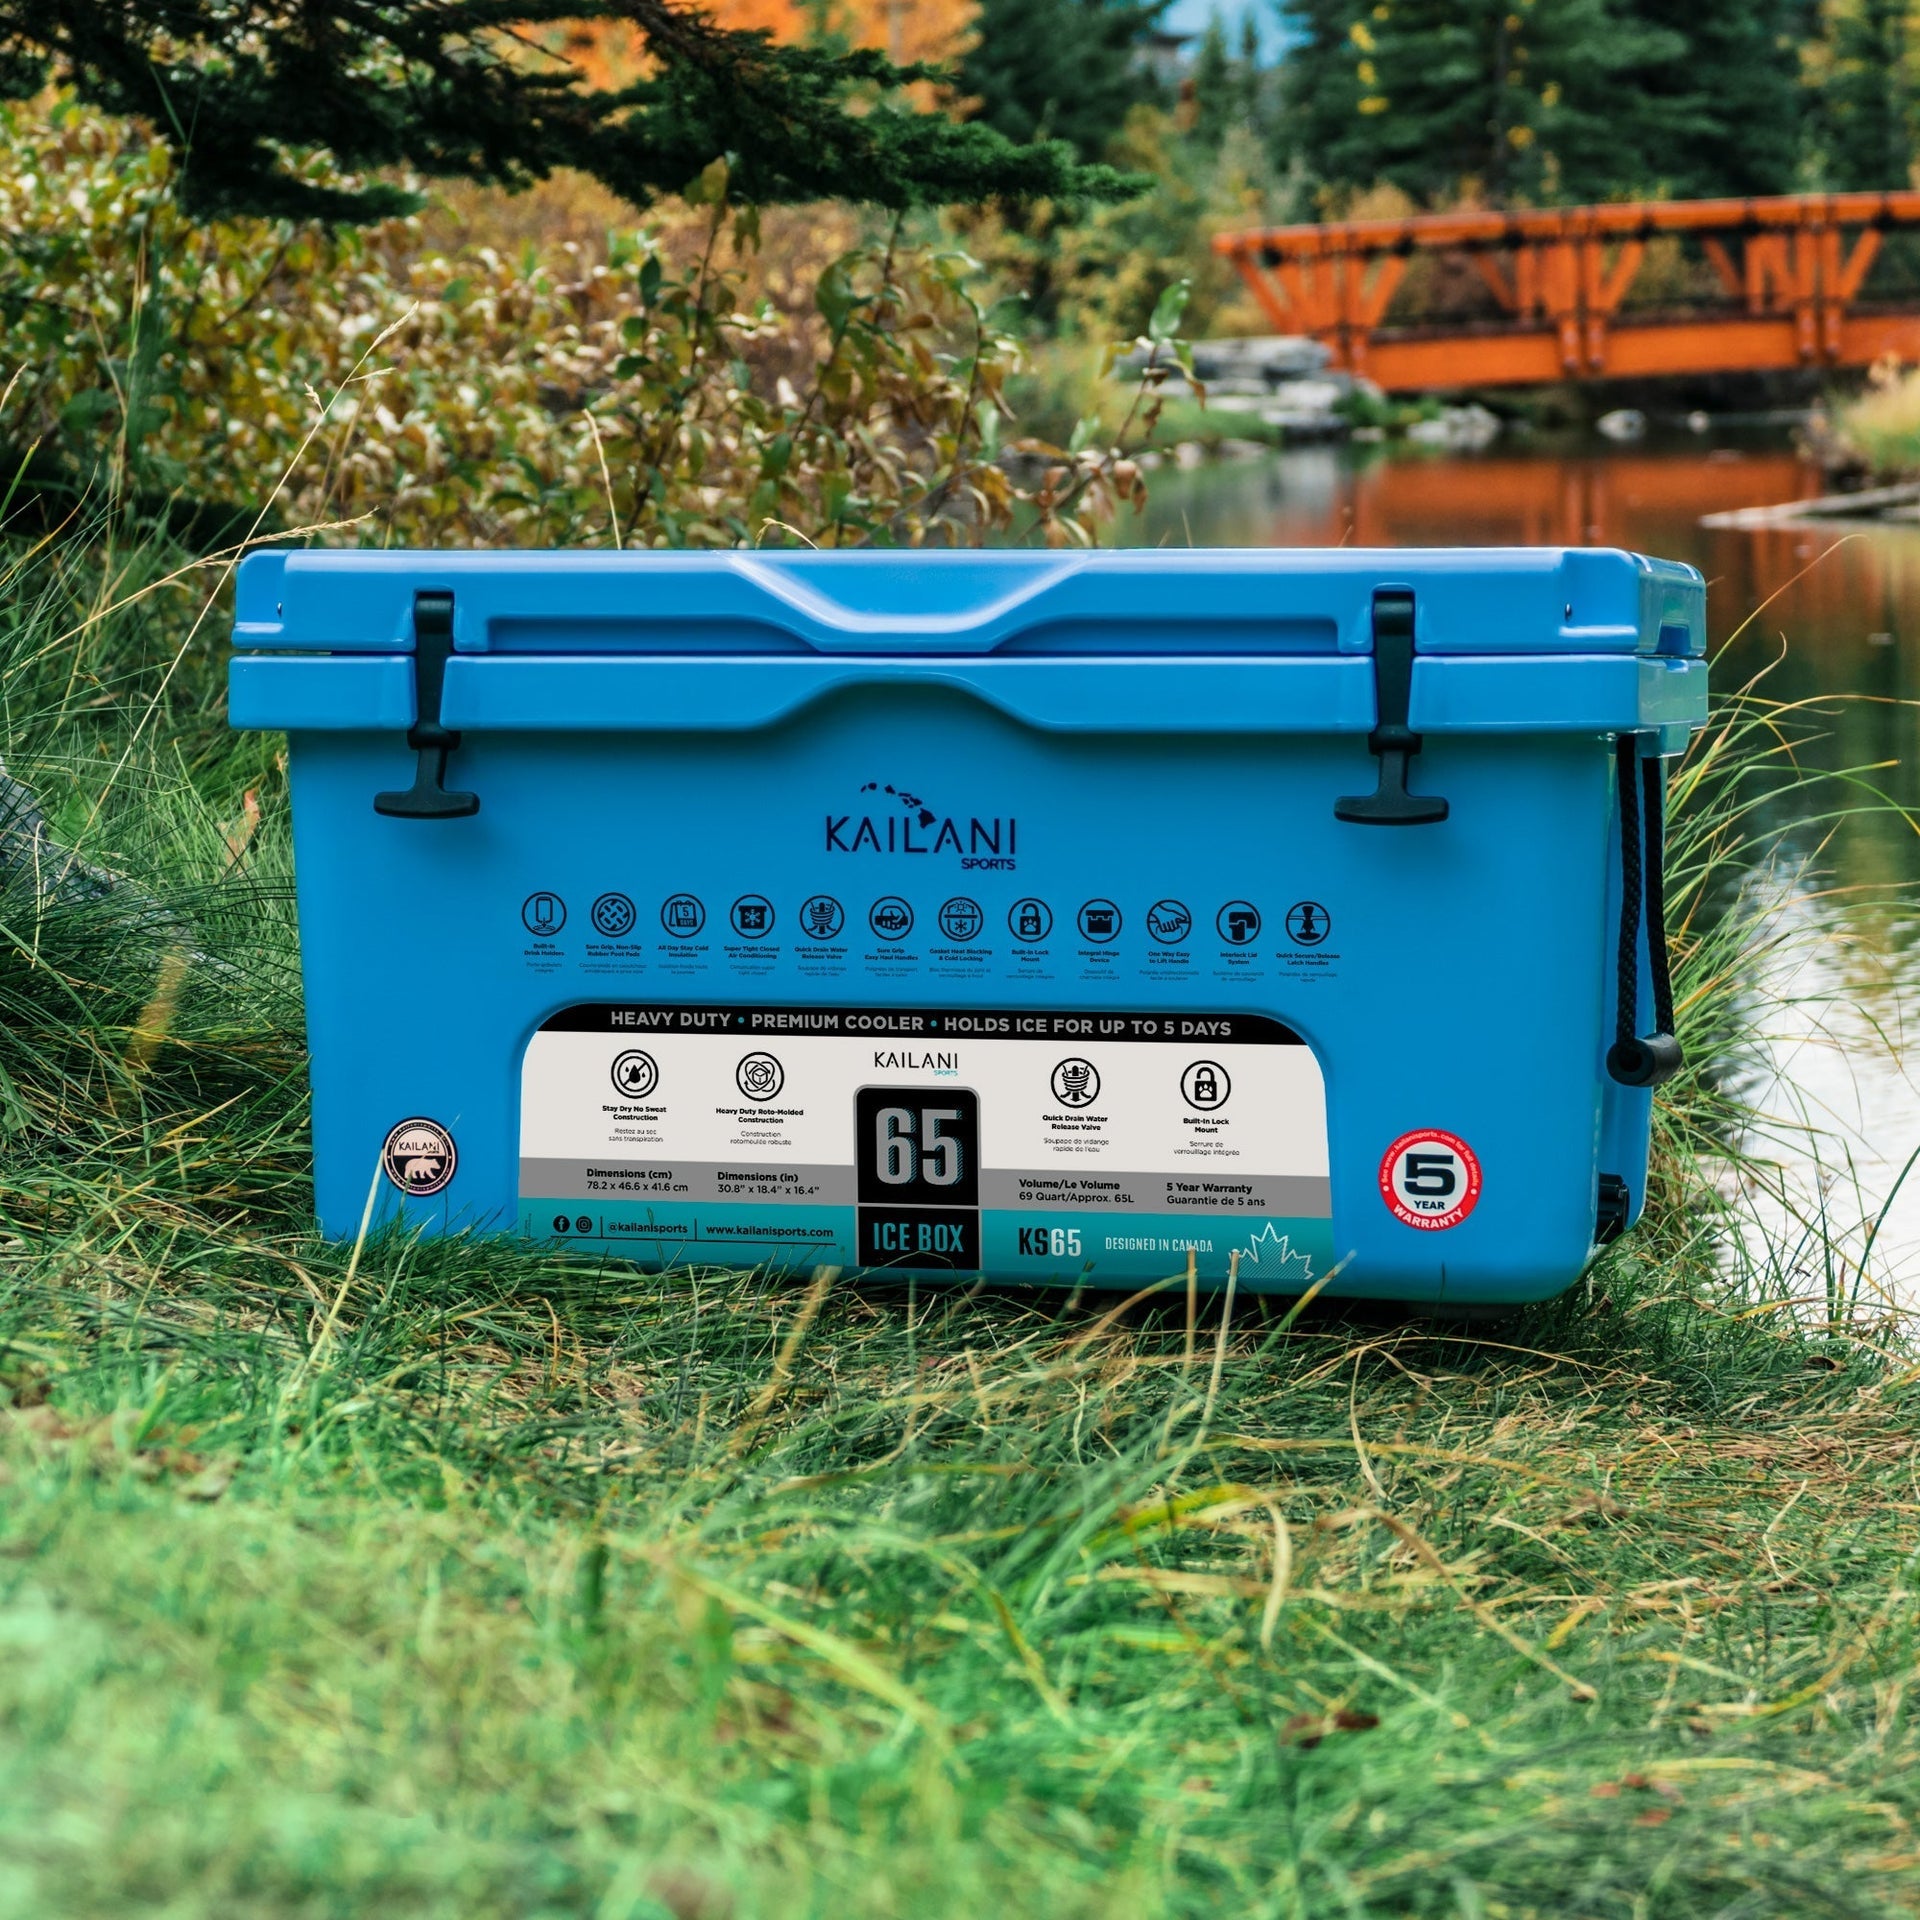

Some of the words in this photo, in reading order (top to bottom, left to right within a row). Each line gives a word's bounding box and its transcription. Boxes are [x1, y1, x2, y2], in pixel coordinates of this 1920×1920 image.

[826, 815, 1016, 854] KAILANI
[961, 858, 1016, 871] SPORTS
[682, 907, 689, 917] 5
[611, 1011, 674, 1026] HEAVY
[680, 1012, 731, 1027] DUTY
[751, 1013, 839, 1029] PREMIUM
[845, 1016, 924, 1031] COOLER
[944, 1017, 1009, 1032] HOLDS
[1016, 1019, 1047, 1033] ICE
[1054, 1019, 1093, 1033] FOR
[1099, 1020, 1126, 1034] UP
[1131, 1020, 1157, 1035] TO
[1164, 1021, 1175, 1035] 5
[1181, 1021, 1231, 1036] DAYS
[875, 1052, 957, 1068] KAILANI
[602, 1105, 618, 1113] Stay
[619, 1106, 632, 1114] Dry
[739, 1108, 756, 1116] Duty
[758, 1108, 804, 1116] Roto-Molded
[399, 1142, 439, 1150] KAILANI
[876, 1107, 963, 1186] 65
[1053, 1146, 1074, 1154] rapide
[1174, 1148, 1211, 1157] verrouillage
[587, 1169, 646, 1178] Dimensions
[649, 1170, 672, 1180] (cm)
[718, 1172, 777, 1181] Dimensions
[780, 1173, 798, 1183] (in)
[1404, 1153, 1455, 1196] 5
[587, 1181, 607, 1190] 78.2
[619, 1182, 640, 1191] 46.6
[651, 1183, 671, 1192] 41.6
[673, 1184, 688, 1192] cm
[1019, 1179, 1077, 1190] Volume/Le
[1081, 1180, 1120, 1190] Volume
[1167, 1183, 1173, 1191] 5
[1176, 1183, 1200, 1192] Year
[1202, 1183, 1252, 1194] Warranty
[1019, 1192, 1033, 1200] 69
[1035, 1192, 1111, 1204] Quart/Approx.
[1114, 1194, 1134, 1203] 65L
[1167, 1195, 1217, 1206] Guarantie
[1221, 1197, 1235, 1205] de
[1238, 1197, 1244, 1205] 5
[1247, 1199, 1266, 1207] ans
[1414, 1201, 1445, 1209] YEAR
[1393, 1204, 1463, 1228] WARRANTY
[609, 1222, 688, 1234] @kailanisports
[707, 1225, 833, 1238] www.kailanisports.com
[873, 1222, 910, 1250] ICE
[918, 1224, 964, 1253] BOX
[1018, 1227, 1082, 1256] KS65
[1106, 1237, 1156, 1250] DESIGNED
[1158, 1239, 1169, 1251] IN
[1172, 1239, 1213, 1253] CANADA
